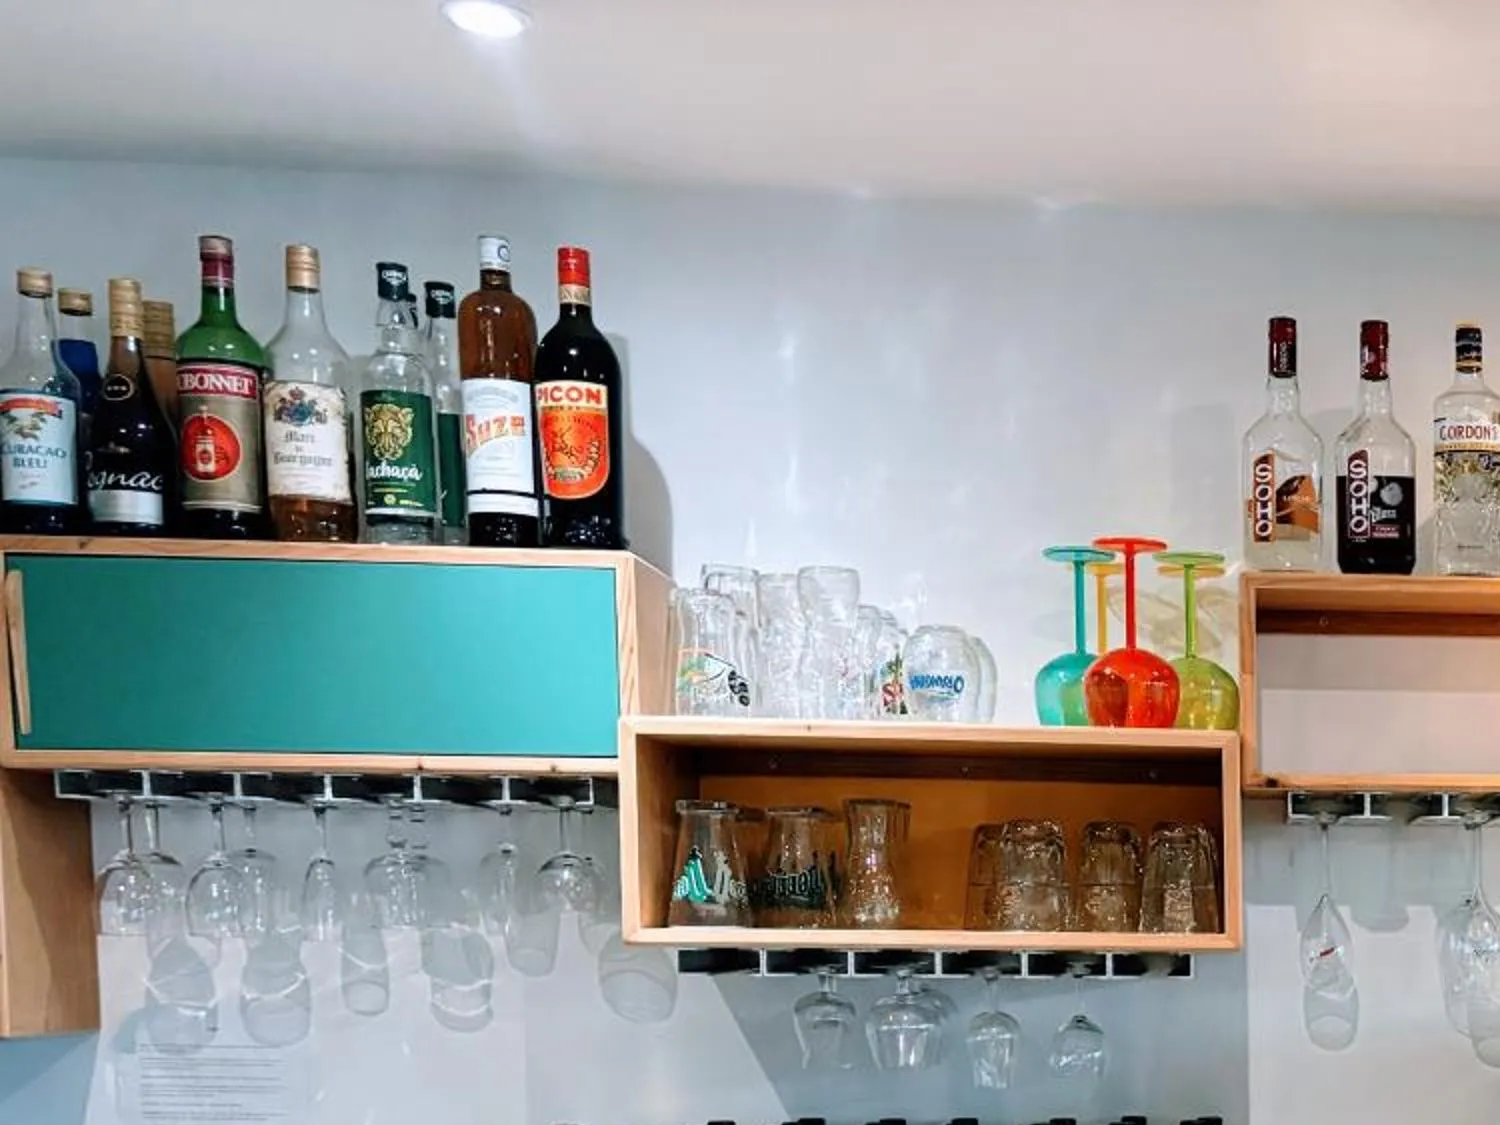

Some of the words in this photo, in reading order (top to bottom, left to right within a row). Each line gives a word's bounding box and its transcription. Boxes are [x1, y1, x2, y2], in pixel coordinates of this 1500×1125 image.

[177, 370, 253, 394] BONNET
[1255, 461, 1274, 537] SOHO
[1349, 459, 1368, 532] SOHO
